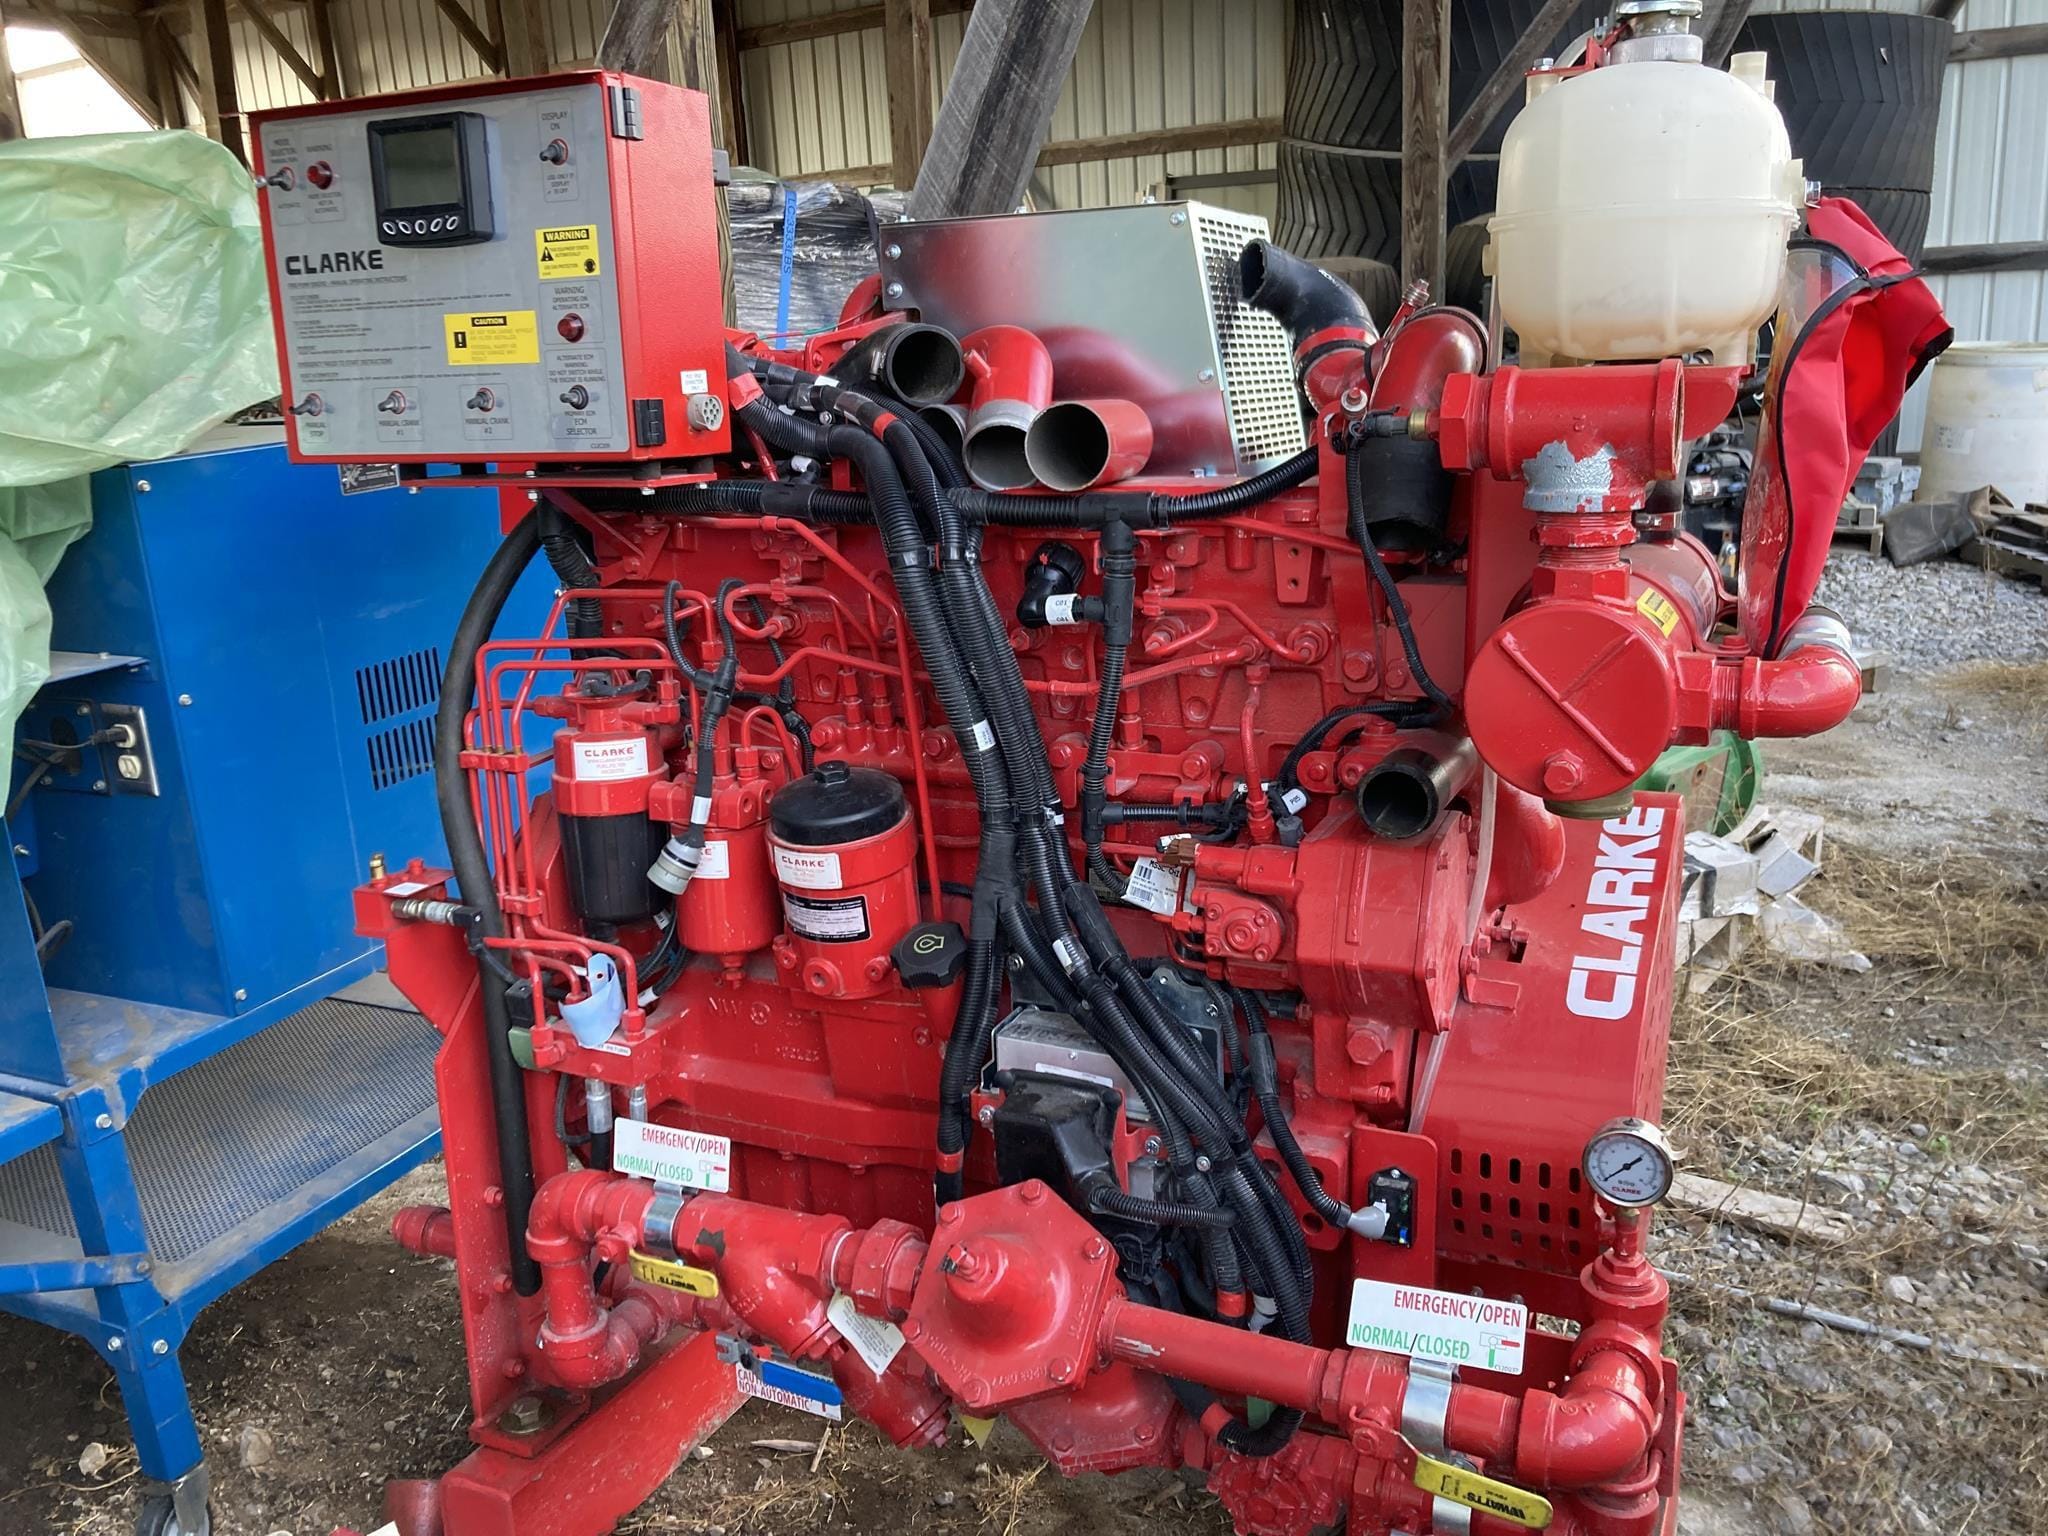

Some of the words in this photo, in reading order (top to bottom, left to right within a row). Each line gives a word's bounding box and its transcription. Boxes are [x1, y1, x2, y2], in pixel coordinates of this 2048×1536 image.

[541, 112, 568, 121] DISPLAY
[550, 123, 560, 131] ON
[545, 230, 588, 241] WARNING
[285, 249, 384, 276] CLARKE
[554, 286, 585, 294] WARNING
[473, 317, 505, 326] CAUTION
[565, 428, 597, 436] SELECTOR
[584, 747, 634, 757] CLARKE
[781, 855, 825, 868] CLARKE
[1566, 806, 1665, 1020] CLARKE
[642, 1127, 727, 1157] EMERGENCY/OPEN
[616, 1153, 694, 1183] NORMAL/CLOSED
[1611, 1186, 1641, 1195] CLARKE
[1394, 1289, 1522, 1328] EMERGENCY/OPEN
[1351, 1323, 1470, 1361] NORMAL/CLOSED
